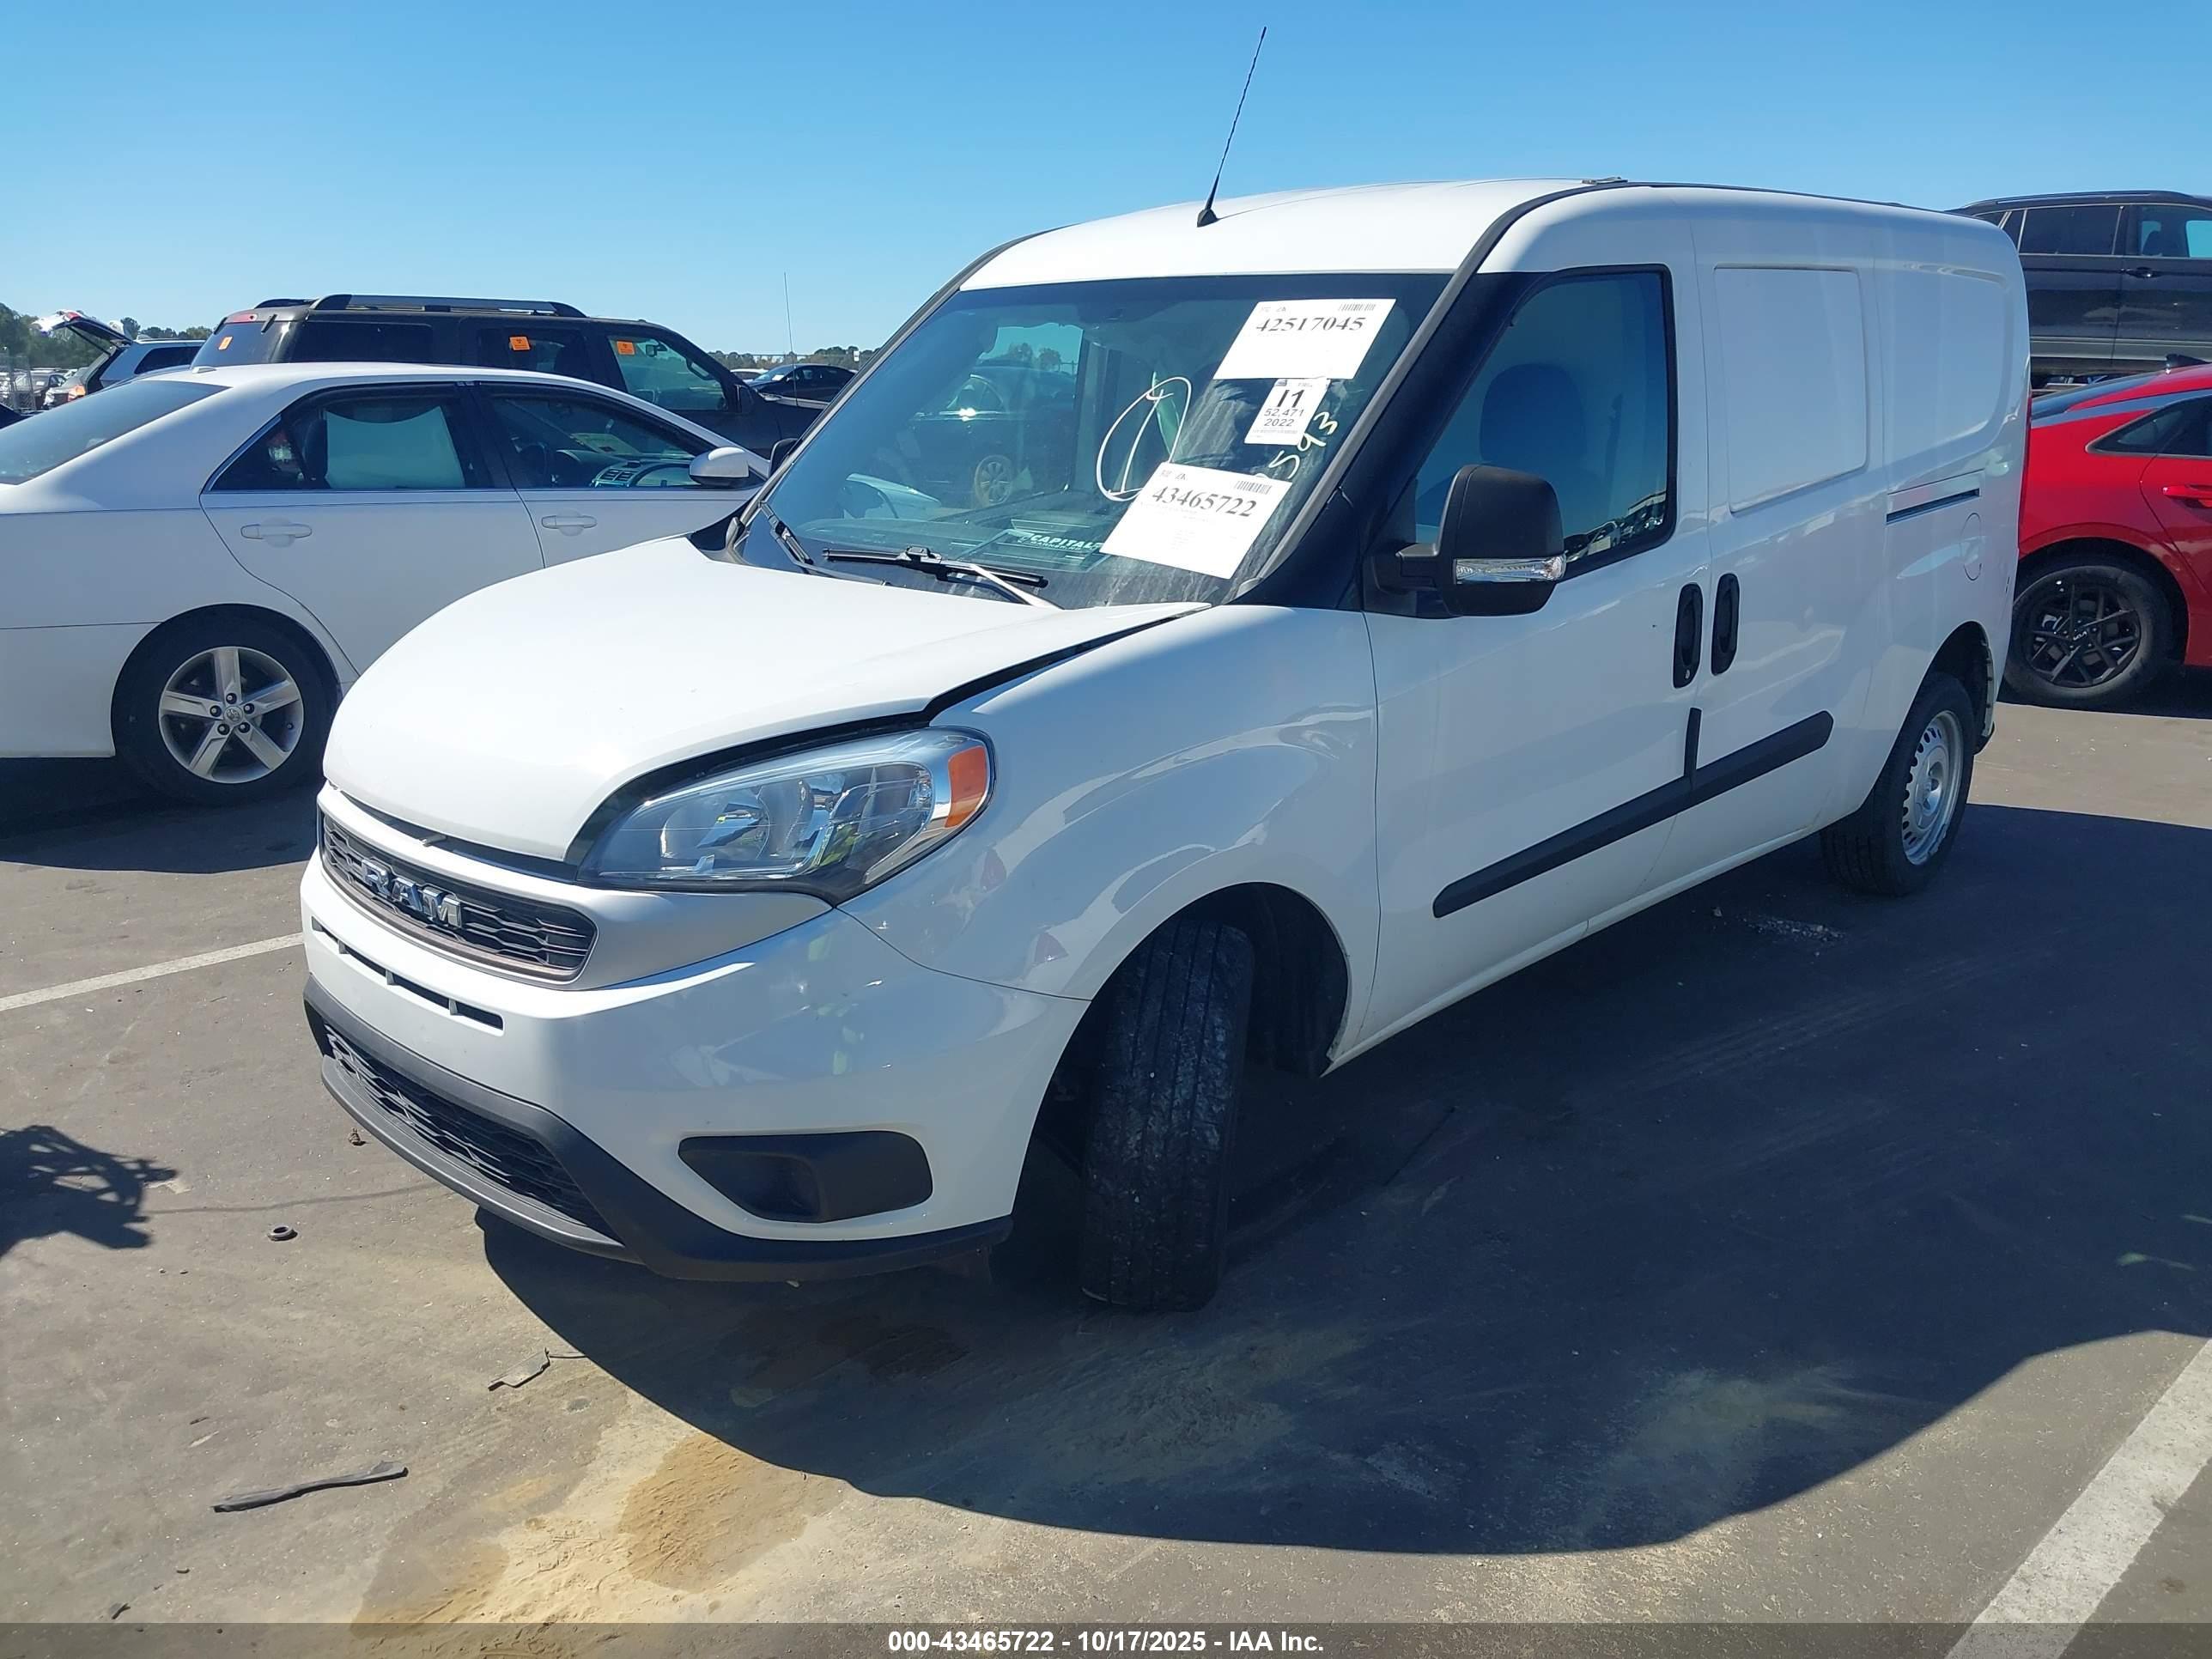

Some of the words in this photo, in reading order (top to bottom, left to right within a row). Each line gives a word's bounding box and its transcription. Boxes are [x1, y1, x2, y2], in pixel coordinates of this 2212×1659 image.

[1255, 316, 1366, 332] 42517045
[1264, 408, 1304, 417] 52,471
[1264, 418, 1295, 427] 2022
[1257, 411, 1339, 480] 593
[1152, 485, 1257, 517] 43465722
[361, 859, 462, 928] RAM
